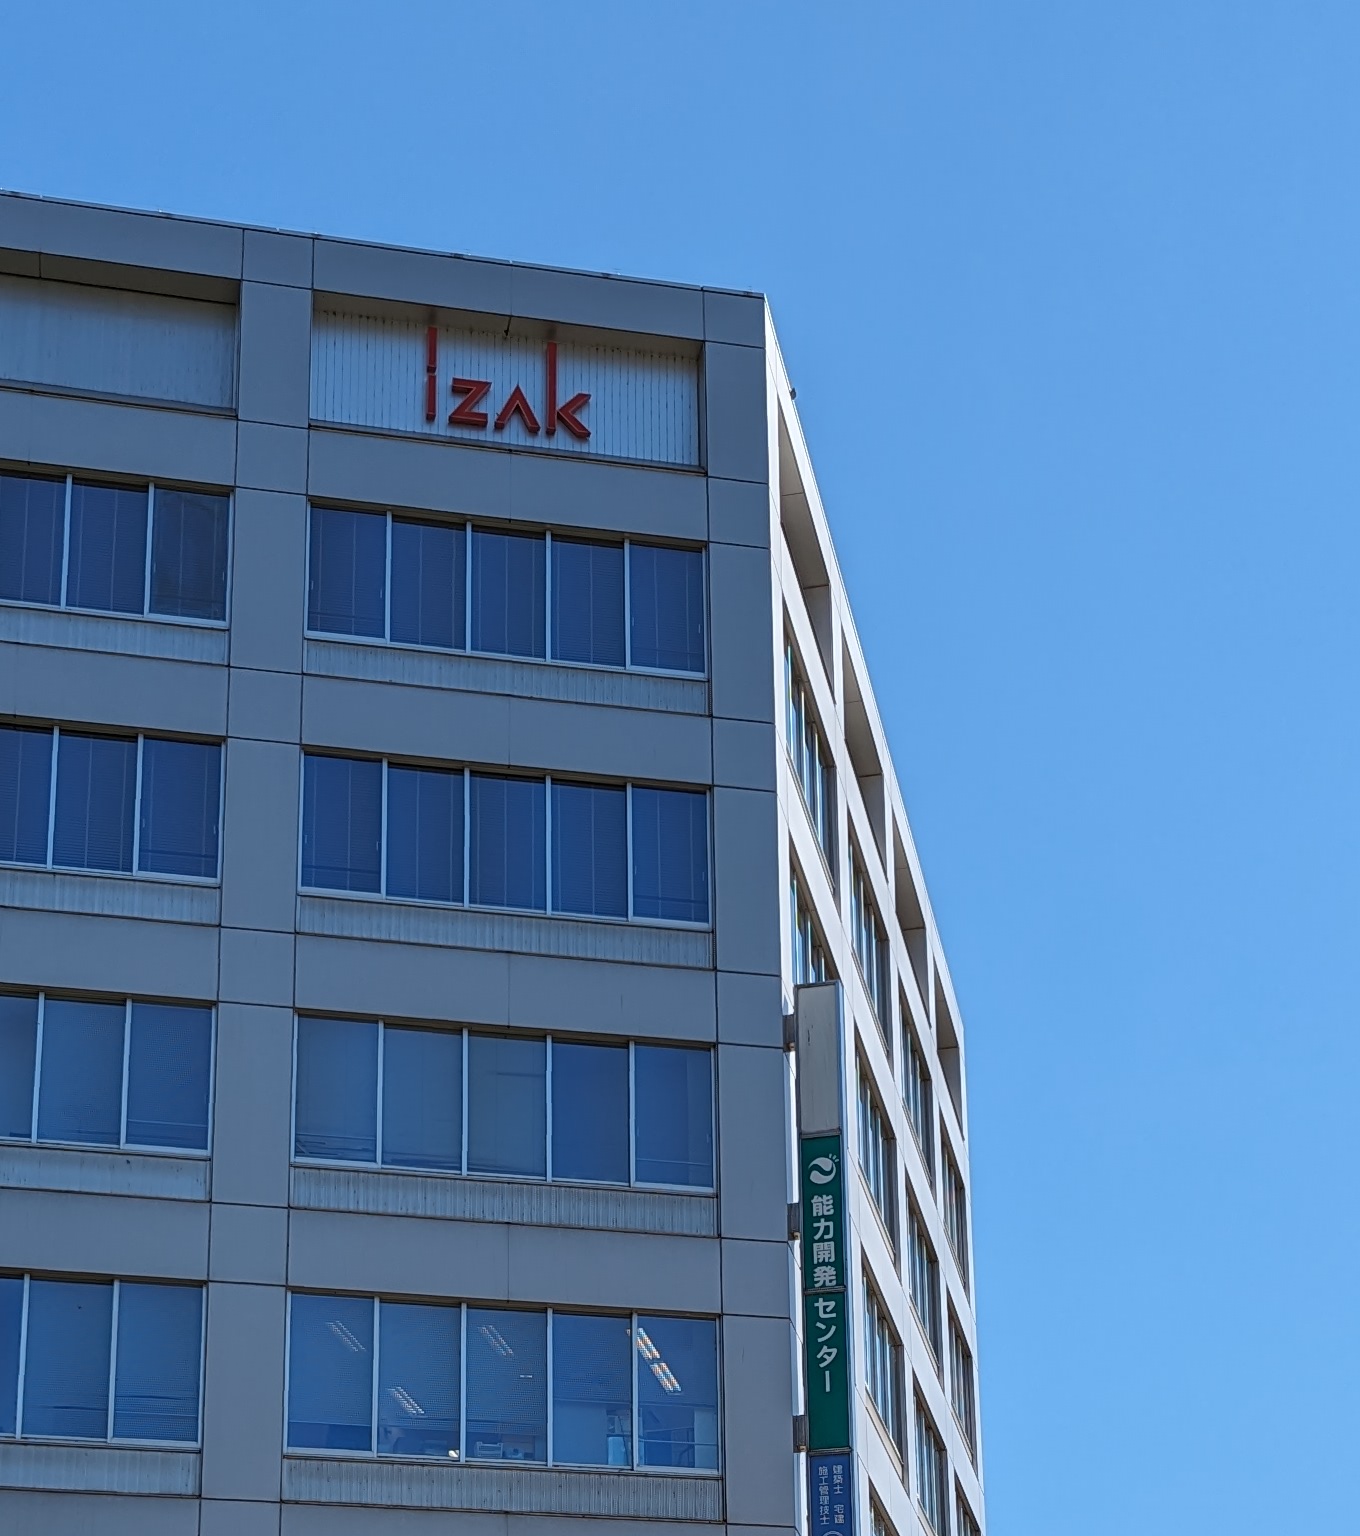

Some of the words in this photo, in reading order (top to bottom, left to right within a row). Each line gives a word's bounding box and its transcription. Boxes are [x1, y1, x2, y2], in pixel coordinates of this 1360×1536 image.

[811, 1194, 838, 1393] 能力開発センター
[818, 1466, 831, 1526] 施工管理技士
[833, 1504, 845, 1525] 宅建
